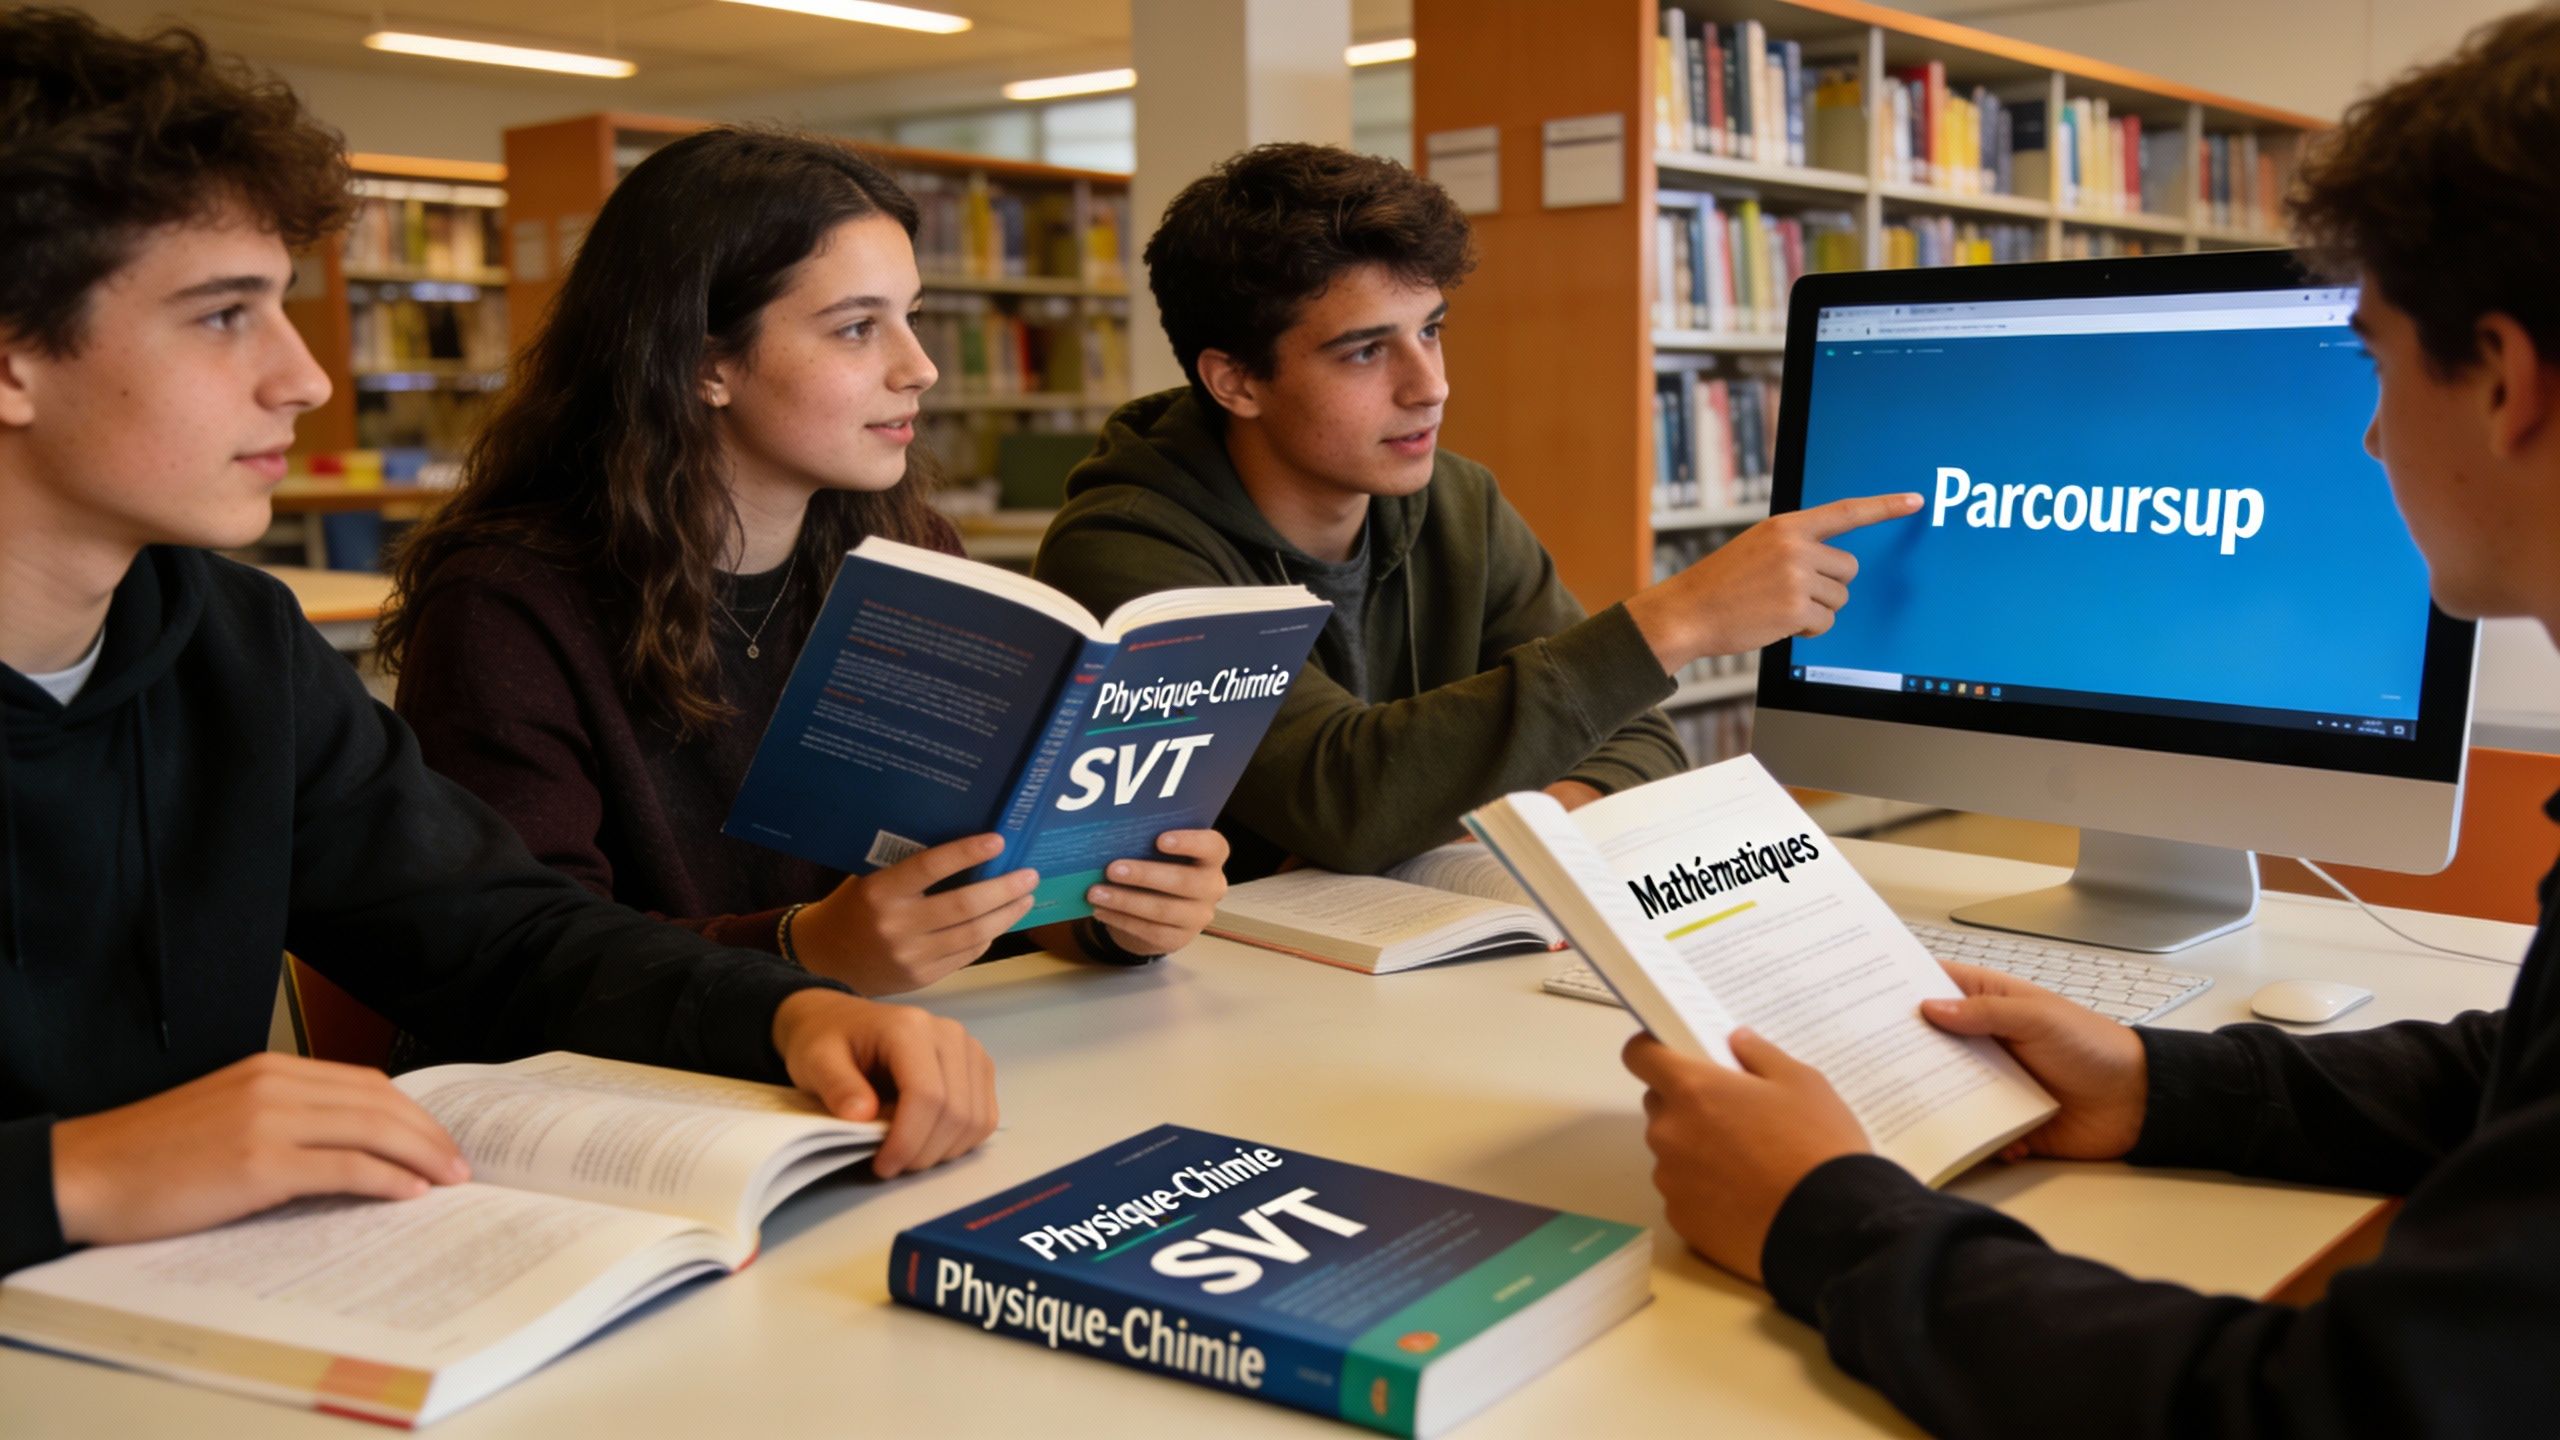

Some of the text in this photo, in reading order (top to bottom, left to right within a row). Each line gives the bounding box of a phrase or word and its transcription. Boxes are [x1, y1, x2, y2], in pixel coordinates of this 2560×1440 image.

[1932, 467, 2264, 555] Parcoursup
[1092, 664, 1289, 723] Physique-Chimie
[1056, 733, 1214, 811] SVT
[1628, 832, 1819, 921] Mathématiques
[1019, 1146, 1283, 1261] Physique-Chimie
[1150, 1187, 1368, 1295] SVT
[934, 1258, 1266, 1390] Physique-Chimie
